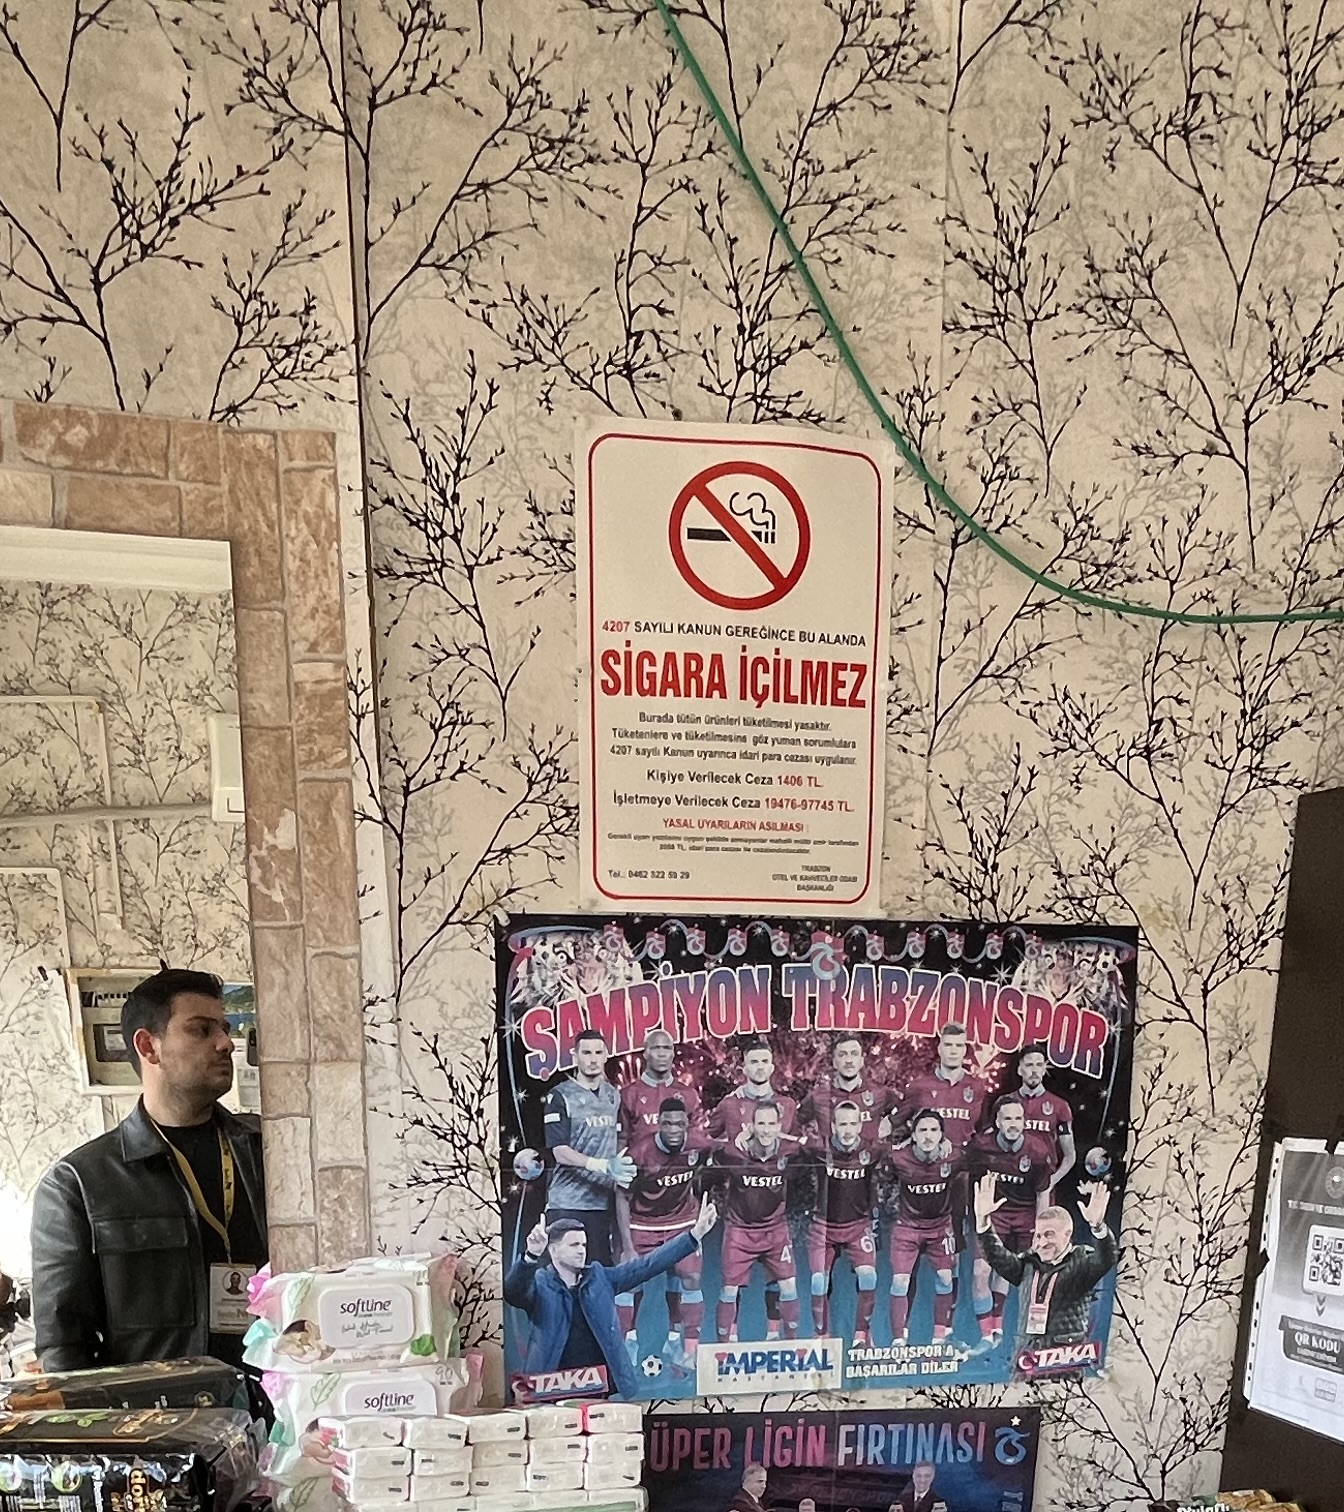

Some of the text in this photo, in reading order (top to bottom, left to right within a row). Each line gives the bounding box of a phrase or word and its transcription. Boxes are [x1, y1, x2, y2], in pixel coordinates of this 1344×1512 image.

[602, 620, 867, 647] 4207 SAYILI KANUN GEREĞİNCE BU ALANDA
[600, 639, 868, 709] SİGARA İÇİLMEZ
[639, 711, 674, 725] Burada
[676, 713, 702, 725] tütün
[743, 716, 793, 730] tüketilmesi
[611, 727, 669, 741] Tüketenlere
[671, 732, 683, 741] ve
[610, 744, 633, 756] 4207
[663, 746, 694, 758] Kanun
[646, 769, 685, 785] Kişiye
[687, 771, 742, 785] Verilecek
[744, 773, 773, 786] Ceza
[613, 790, 672, 809] İşletmeye
[674, 793, 729, 808] Verilecek
[731, 796, 761, 809] Ceza
[662, 817, 695, 830] YASAL
[522, 961, 1111, 1082] ŞAMPİYON TRABZONSPOR
[741, 1174, 784, 1188] VESTEL
[340, 1298, 392, 1317] softline
[1312, 1333, 1341, 1355] KODU
[1035, 1343, 1098, 1369] TAKA
[529, 1367, 605, 1394] TAKA
[364, 1392, 415, 1412] softline
[650, 1416, 987, 1473] ÜPER LİGİN FIRTINASI
